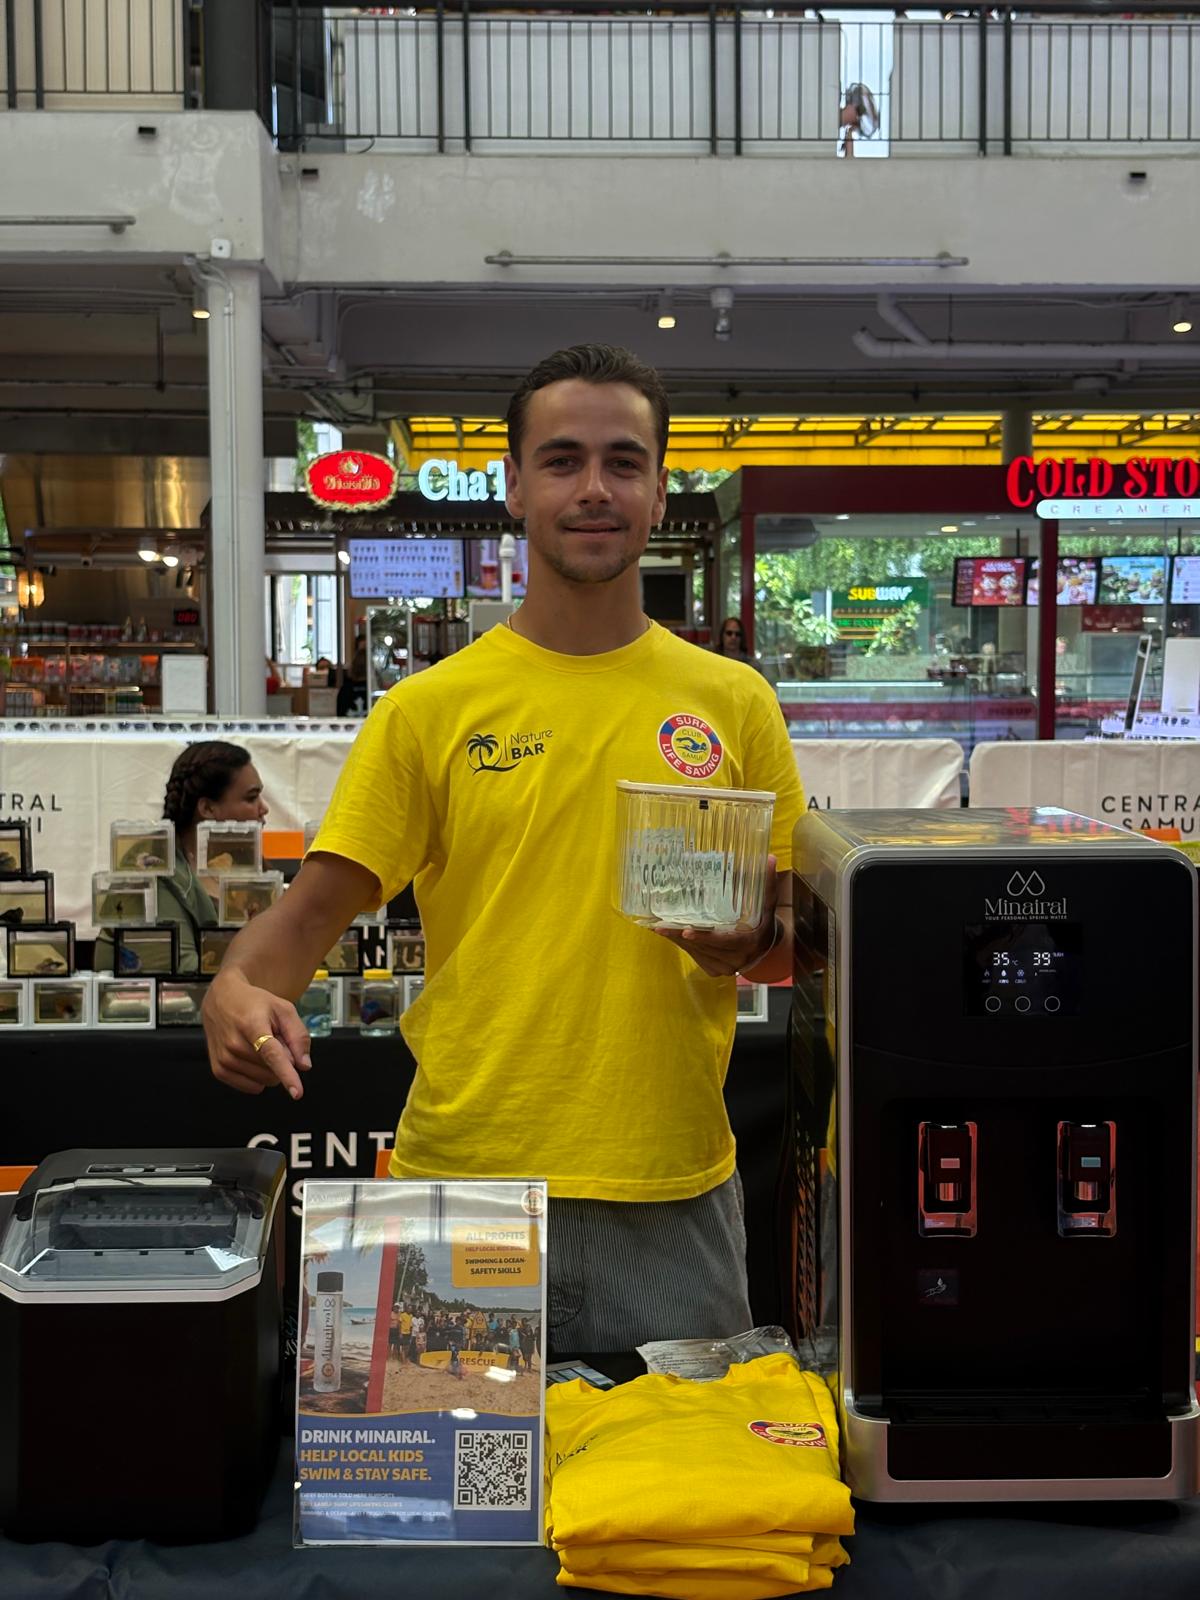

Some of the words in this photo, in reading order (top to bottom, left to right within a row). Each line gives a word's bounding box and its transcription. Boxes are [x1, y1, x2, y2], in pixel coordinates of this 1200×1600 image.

[1006, 455, 1114, 508] COLD
[1123, 456, 1200, 498] STO
[847, 586, 913, 601] SUBWAY
[675, 716, 708, 731] SURF
[510, 729, 553, 745] Nature
[681, 729, 702, 738] CLUB
[511, 742, 545, 760] BAR
[661, 743, 682, 769] LIFE
[685, 753, 720, 777] SAVING
[984, 897, 1067, 916] Minairal
[993, 952, 1010, 966] 35
[1033, 952, 1051, 966] 39
[466, 1232, 484, 1241] ALL
[485, 1231, 526, 1241] PROFITS
[470, 1267, 497, 1275] SAFETY
[497, 1266, 522, 1274] SKILLS
[459, 1357, 496, 1366] RESCUE
[301, 1429, 353, 1444] DRINK
[355, 1429, 436, 1444] MINAIRAL.
[300, 1449, 338, 1462] HELP
[340, 1449, 387, 1462] LOCAL
[388, 1449, 424, 1462] KIDS
[300, 1467, 341, 1480] SWIM
[342, 1467, 353, 1480] &
[355, 1467, 390, 1480] STAY
[392, 1467, 432, 1480] SAFE.
